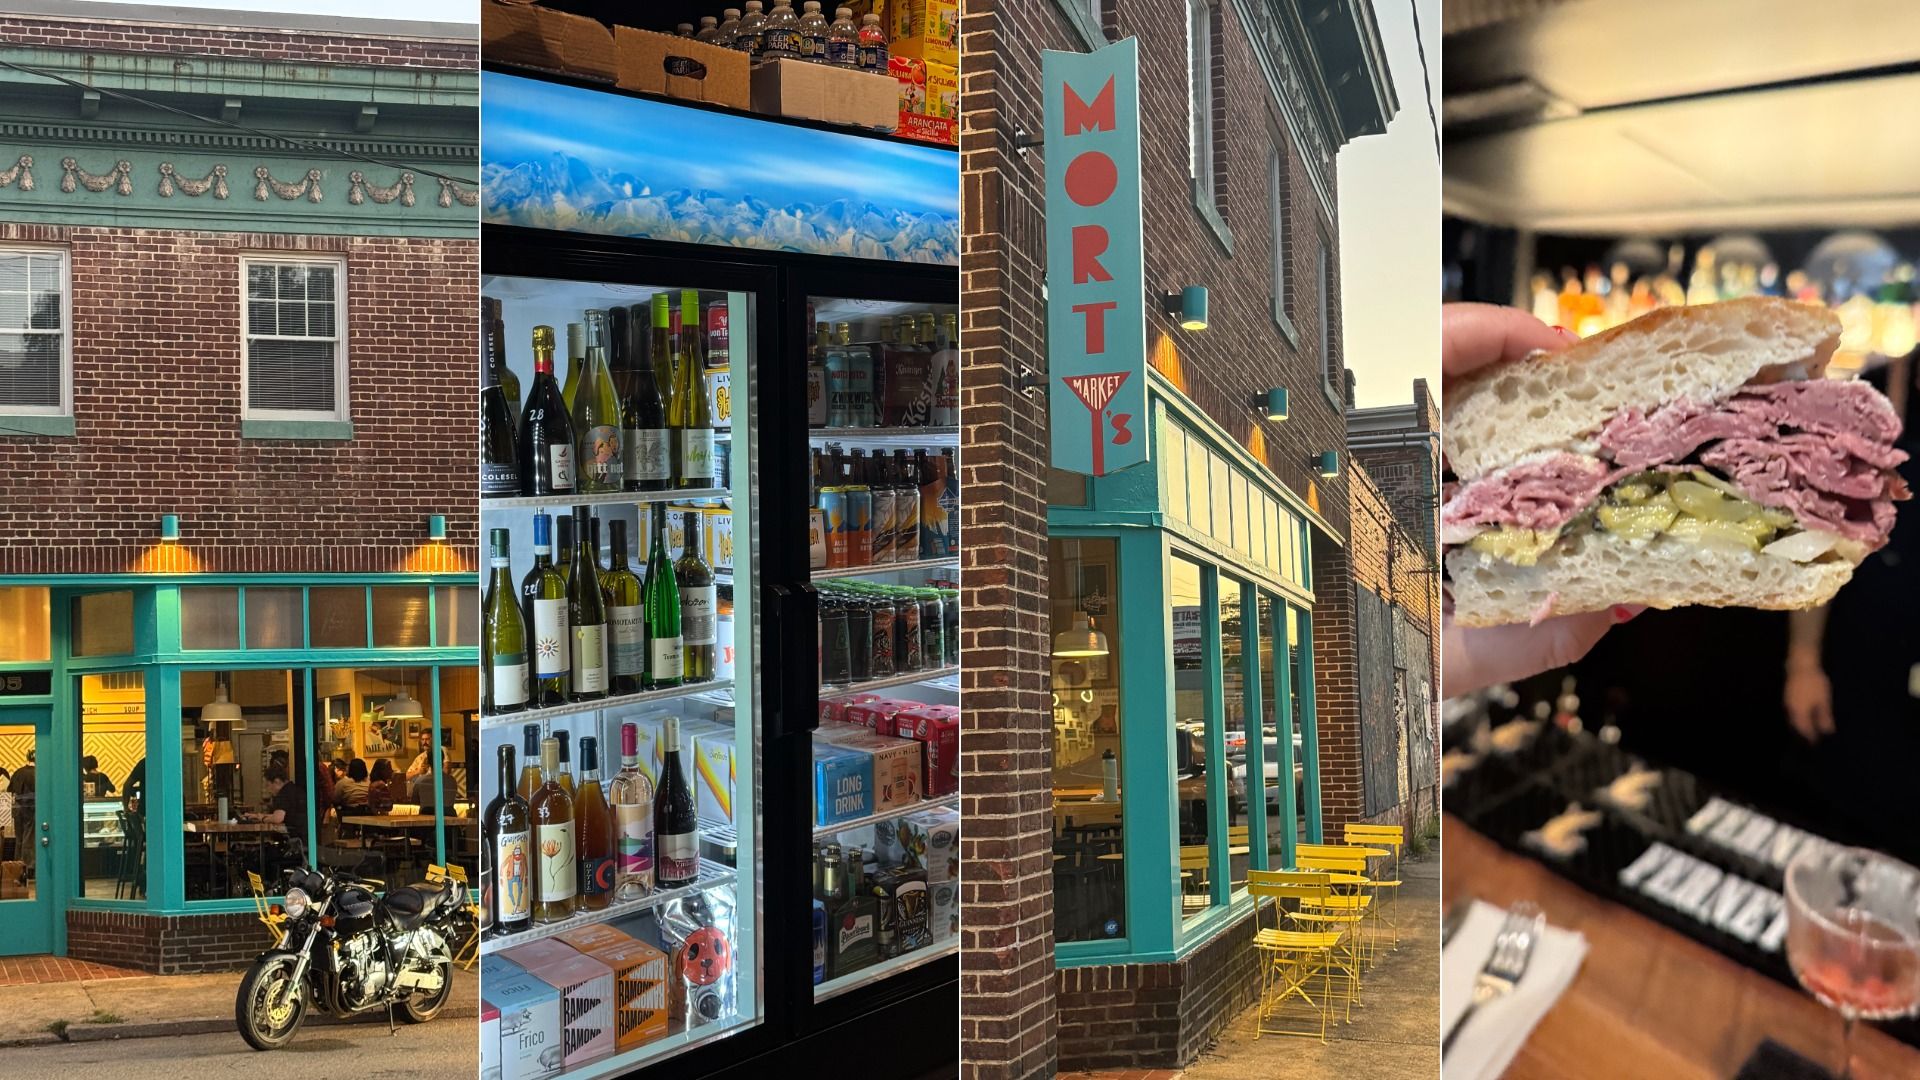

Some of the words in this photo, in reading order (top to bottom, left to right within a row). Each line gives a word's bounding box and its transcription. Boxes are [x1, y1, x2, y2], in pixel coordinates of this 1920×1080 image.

[767, 41, 789, 50] PARK
[768, 34, 789, 43] DEER
[907, 116, 948, 131] ARANCIATA
[1072, 375, 1120, 411] MARKET
[529, 408, 544, 421] 28
[879, 751, 897, 761] NAVY
[902, 746, 919, 756] HILL
[837, 774, 863, 795] LONG
[537, 806, 551, 818] 33
[835, 793, 864, 816] DRINK
[519, 1030, 545, 1051] Frico
